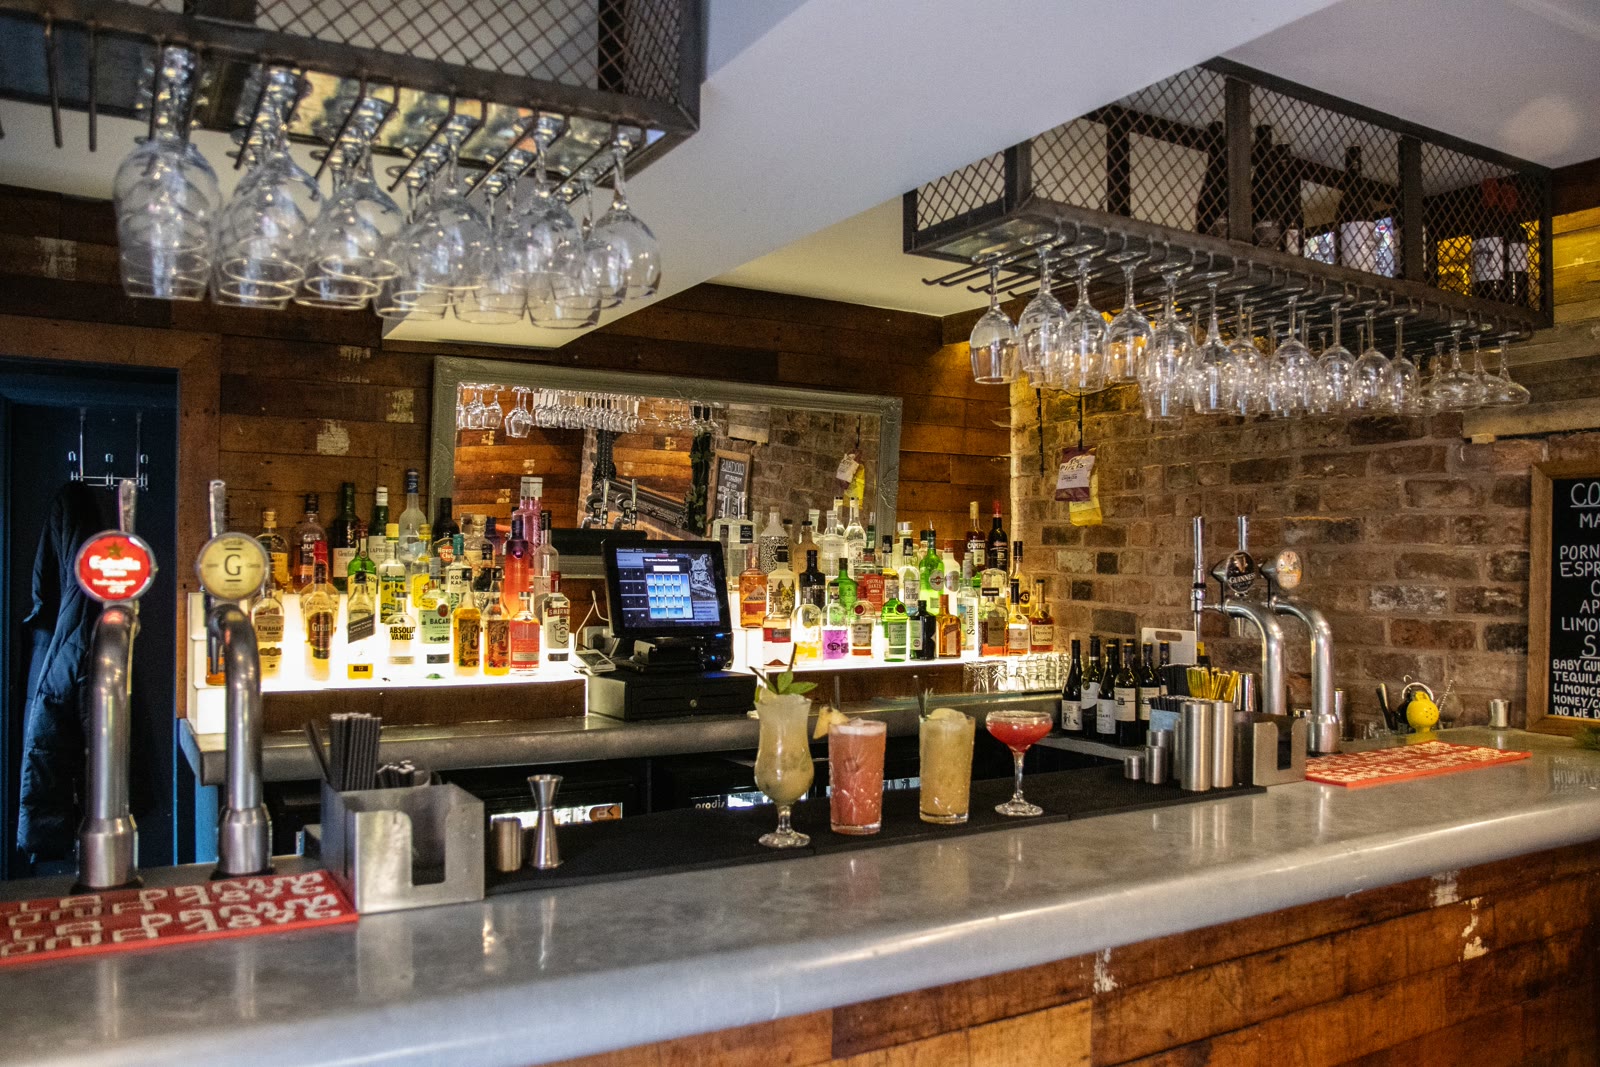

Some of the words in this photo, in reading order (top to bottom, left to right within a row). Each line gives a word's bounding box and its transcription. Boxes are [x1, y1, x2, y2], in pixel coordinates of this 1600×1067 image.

[1571, 482, 1600, 507] CO
[1559, 544, 1600, 560] PORN
[224, 554, 242, 576] G
[1560, 561, 1600, 577] ESPR
[1579, 599, 1600, 614] AP
[1561, 616, 1600, 632] LIMO
[1552, 658, 1581, 671] BABY
[1552, 670, 1600, 684] TEQUILA
[1553, 683, 1600, 698] LIMONCE
[1552, 694, 1600, 709] HONEY/C
[1554, 705, 1569, 716] NO
[1573, 707, 1589, 718] WE
